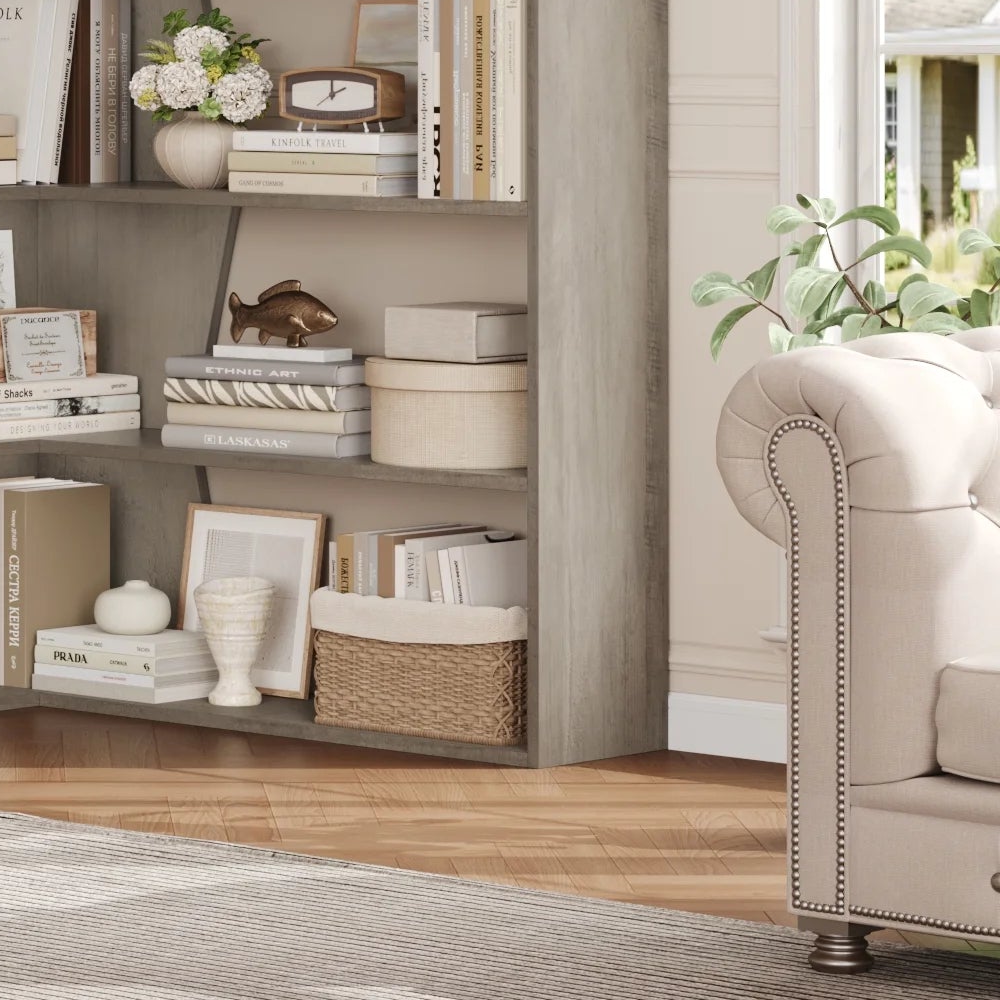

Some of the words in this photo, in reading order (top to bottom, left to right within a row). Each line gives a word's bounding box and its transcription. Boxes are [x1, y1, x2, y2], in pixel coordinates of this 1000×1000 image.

[107, 47, 116, 63] НЕ
[63, 58, 72, 91] Религия
[107, 65, 117, 95] БЕРИ
[107, 109, 117, 156] ГОЛОВУ
[271, 138, 312, 147] KINFOLK
[316, 138, 346, 148] TRAVEL
[205, 366, 263, 376] ETHNIC
[268, 369, 299, 379] ART
[4, 388, 33, 399] Shacks
[10, 423, 50, 435] DESIGNING
[53, 420, 72, 432] YOUR
[75, 419, 99, 430] WORLD
[218, 435, 288, 449] LASKASAS
[8, 553, 20, 604] СЕСТРА
[8, 606, 20, 647] КЕРРИ
[53, 650, 88, 664] PRADA
